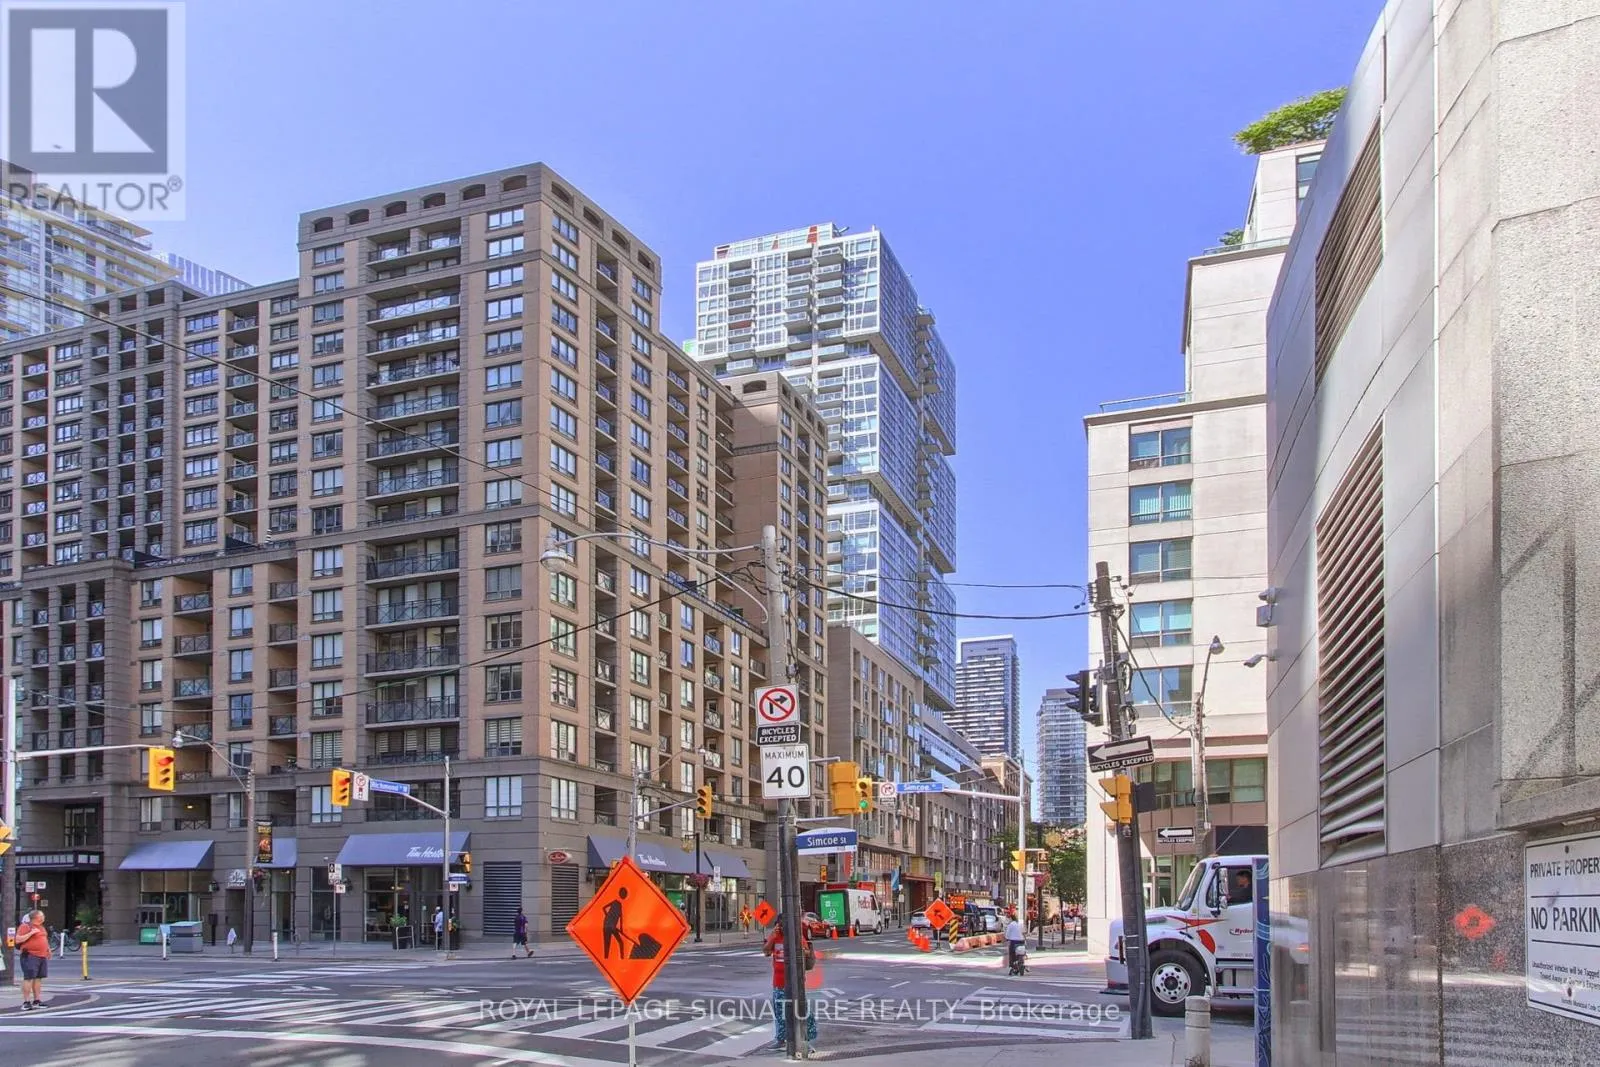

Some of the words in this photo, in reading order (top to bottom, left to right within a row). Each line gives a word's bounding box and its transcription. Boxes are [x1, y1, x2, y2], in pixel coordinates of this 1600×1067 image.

[761, 727, 796, 736] BICYCLES
[759, 734, 797, 744] EXCEPTED
[764, 751, 805, 760] MAXIMUM
[1091, 760, 1120, 771] BICYCLES
[1121, 755, 1154, 766] EXCEPTED
[766, 765, 805, 789] 40
[807, 836, 839, 847] Simcoe
[406, 846, 421, 858] Tim
[637, 854, 649, 865] Tim
[1530, 861, 1561, 878] PRIVATE
[1564, 856, 1600, 876] PROPER
[1530, 906, 1548, 930] NO
